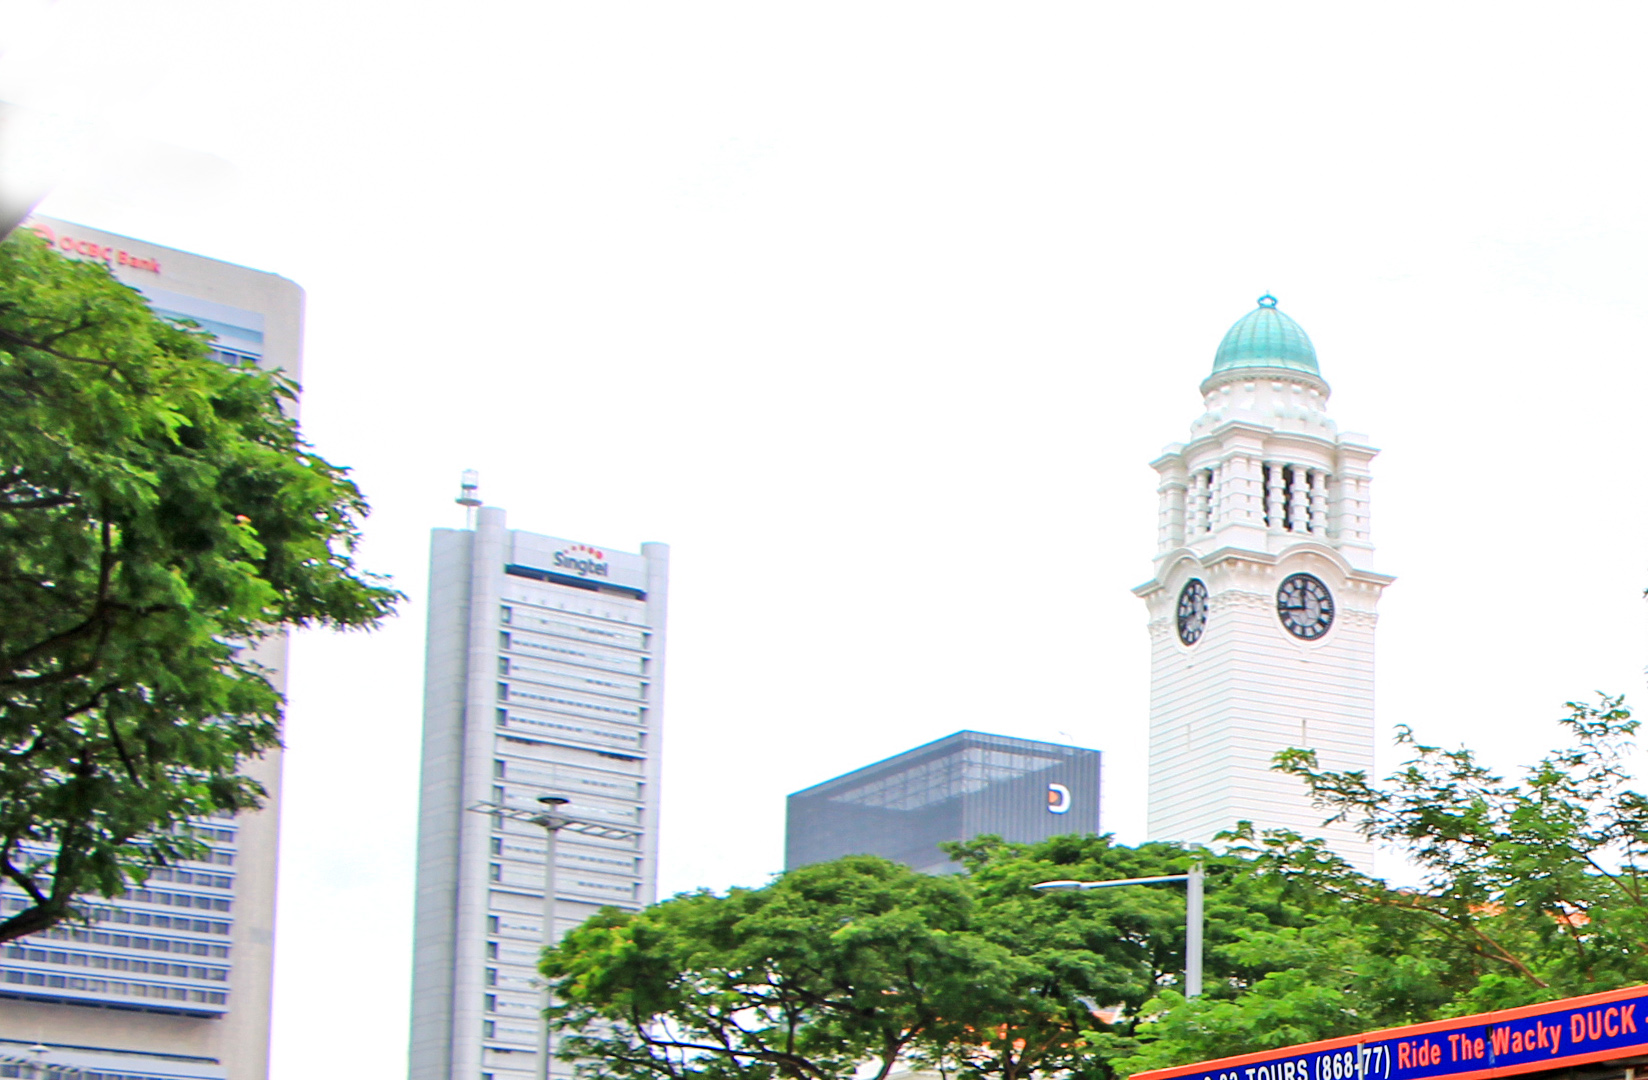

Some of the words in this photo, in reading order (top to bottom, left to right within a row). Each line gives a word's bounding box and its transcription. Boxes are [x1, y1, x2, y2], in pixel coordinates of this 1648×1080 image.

[60, 236, 113, 261] OCBC
[117, 250, 161, 274] Bank
[553, 550, 608, 576] Singtel
[1397, 1038, 1442, 1070] Ride
[1447, 1033, 1485, 1062] The
[1490, 1020, 1563, 1054] Wacky
[1569, 1003, 1638, 1043] DUCK
